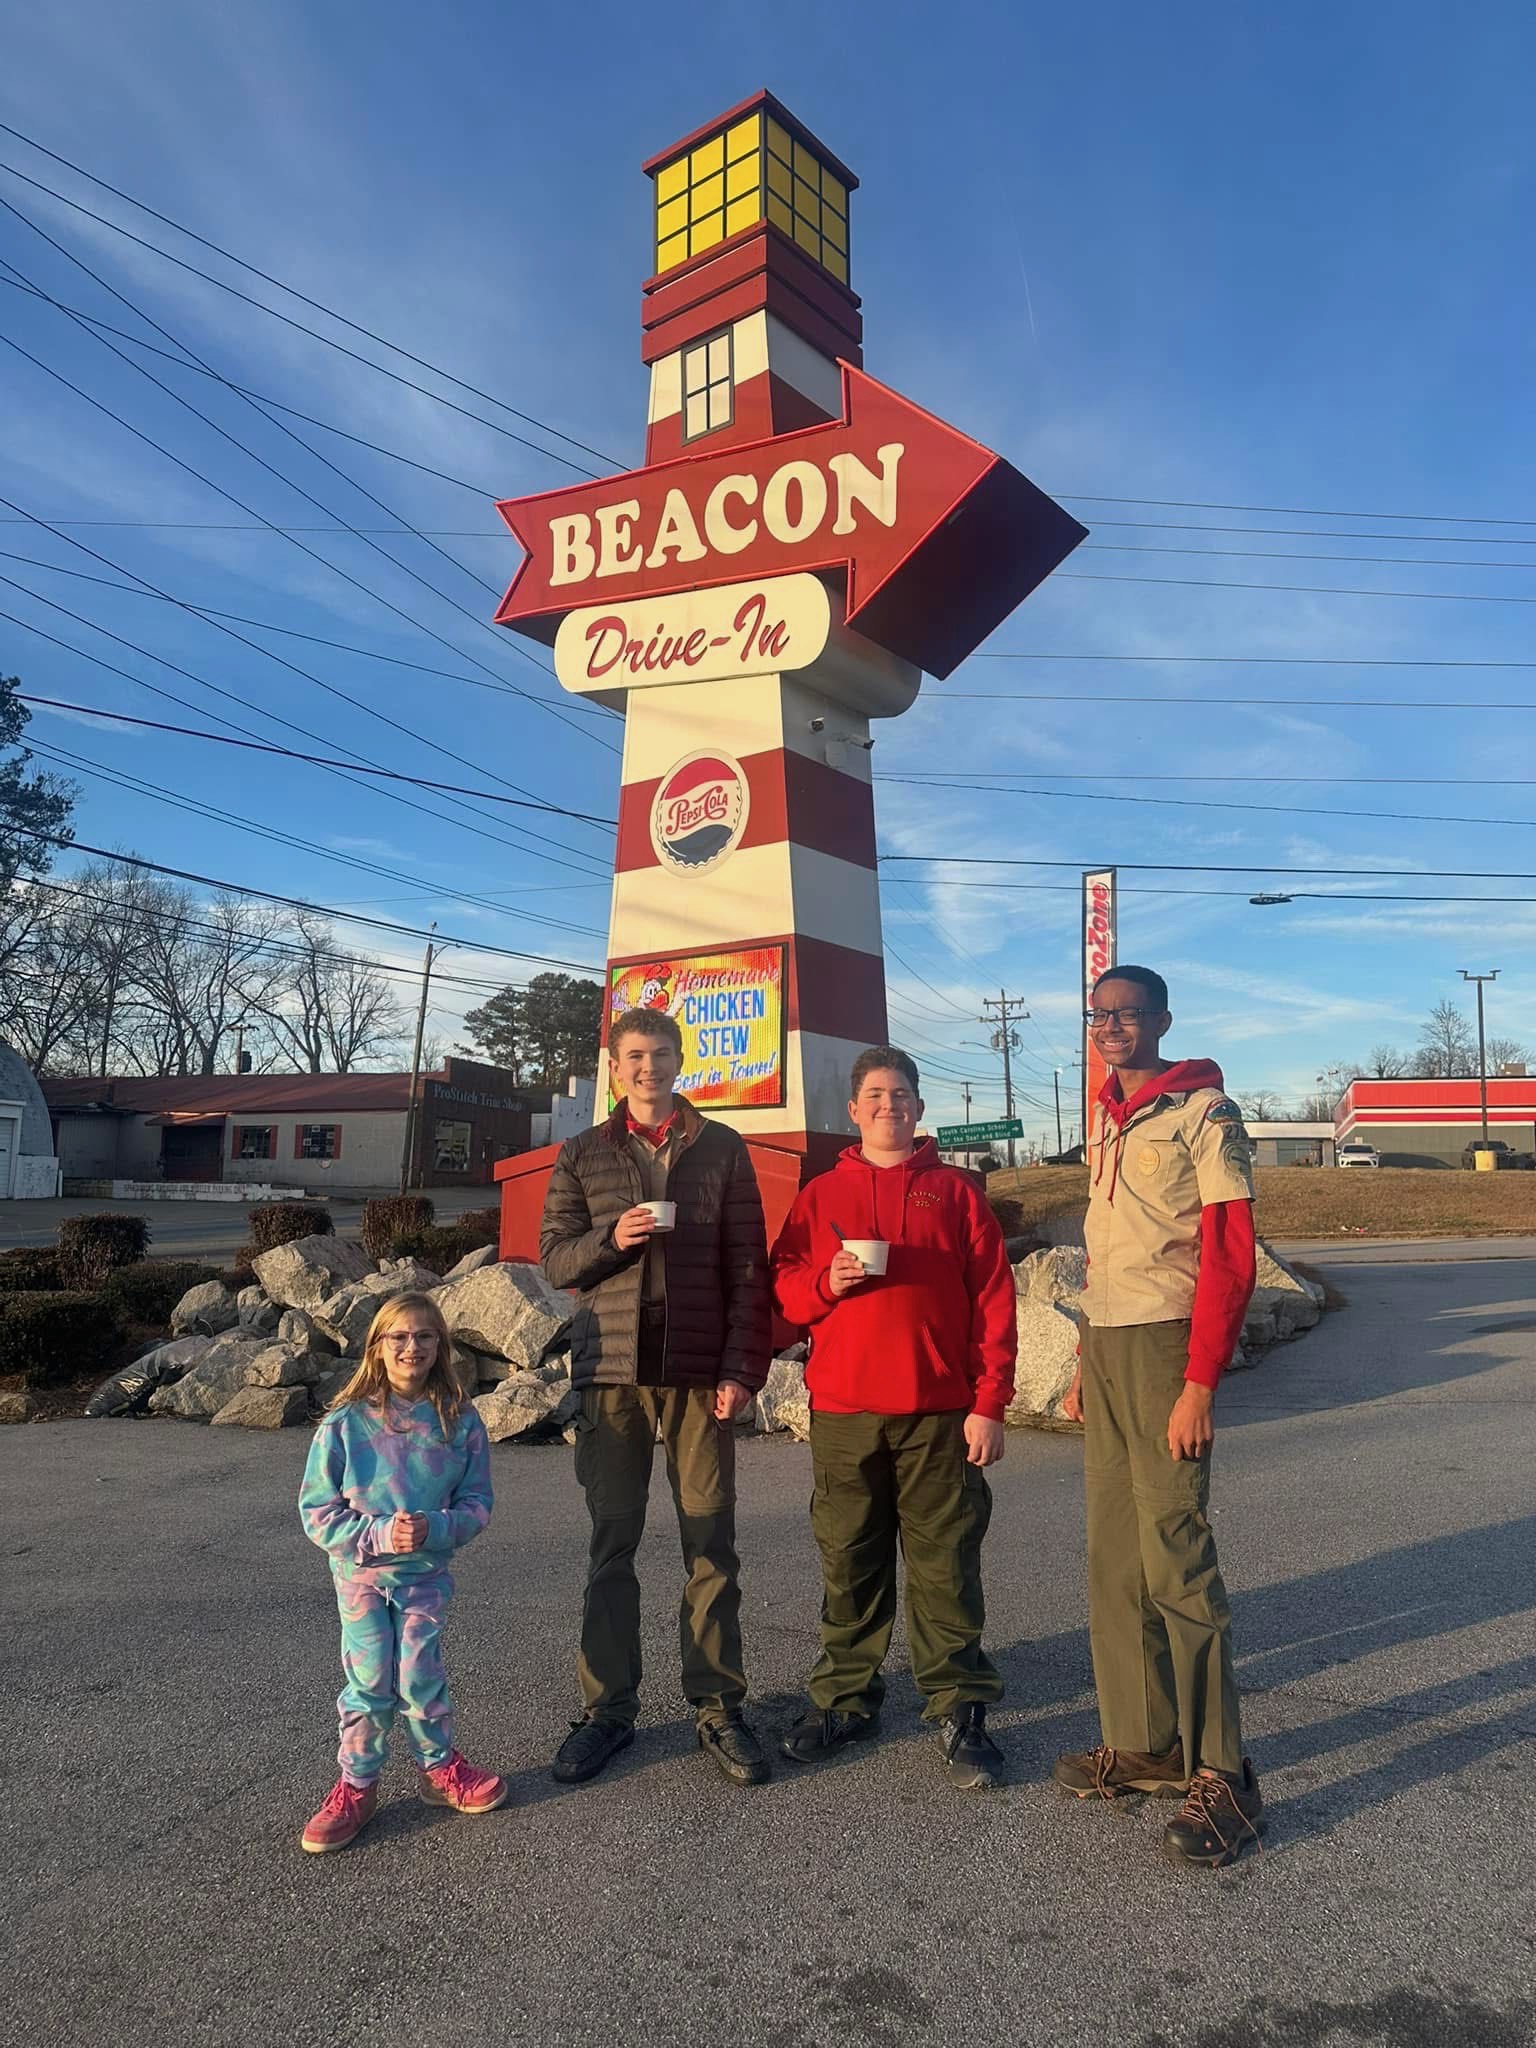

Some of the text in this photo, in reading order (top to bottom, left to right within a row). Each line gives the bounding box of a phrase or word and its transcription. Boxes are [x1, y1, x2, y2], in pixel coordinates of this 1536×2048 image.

[548, 442, 905, 586] BEACON
[585, 592, 790, 678] Drive-In
[675, 963, 778, 990] Homemade
[685, 988, 765, 1025] CHICKEN
[697, 1025, 749, 1058] STEW
[708, 1065, 722, 1084] in
[729, 1051, 776, 1081] Town!
[941, 1122, 1007, 1136] South Carolina School
[965, 1133, 980, 1141] Deaf
[995, 1130, 1011, 1138] Blind
